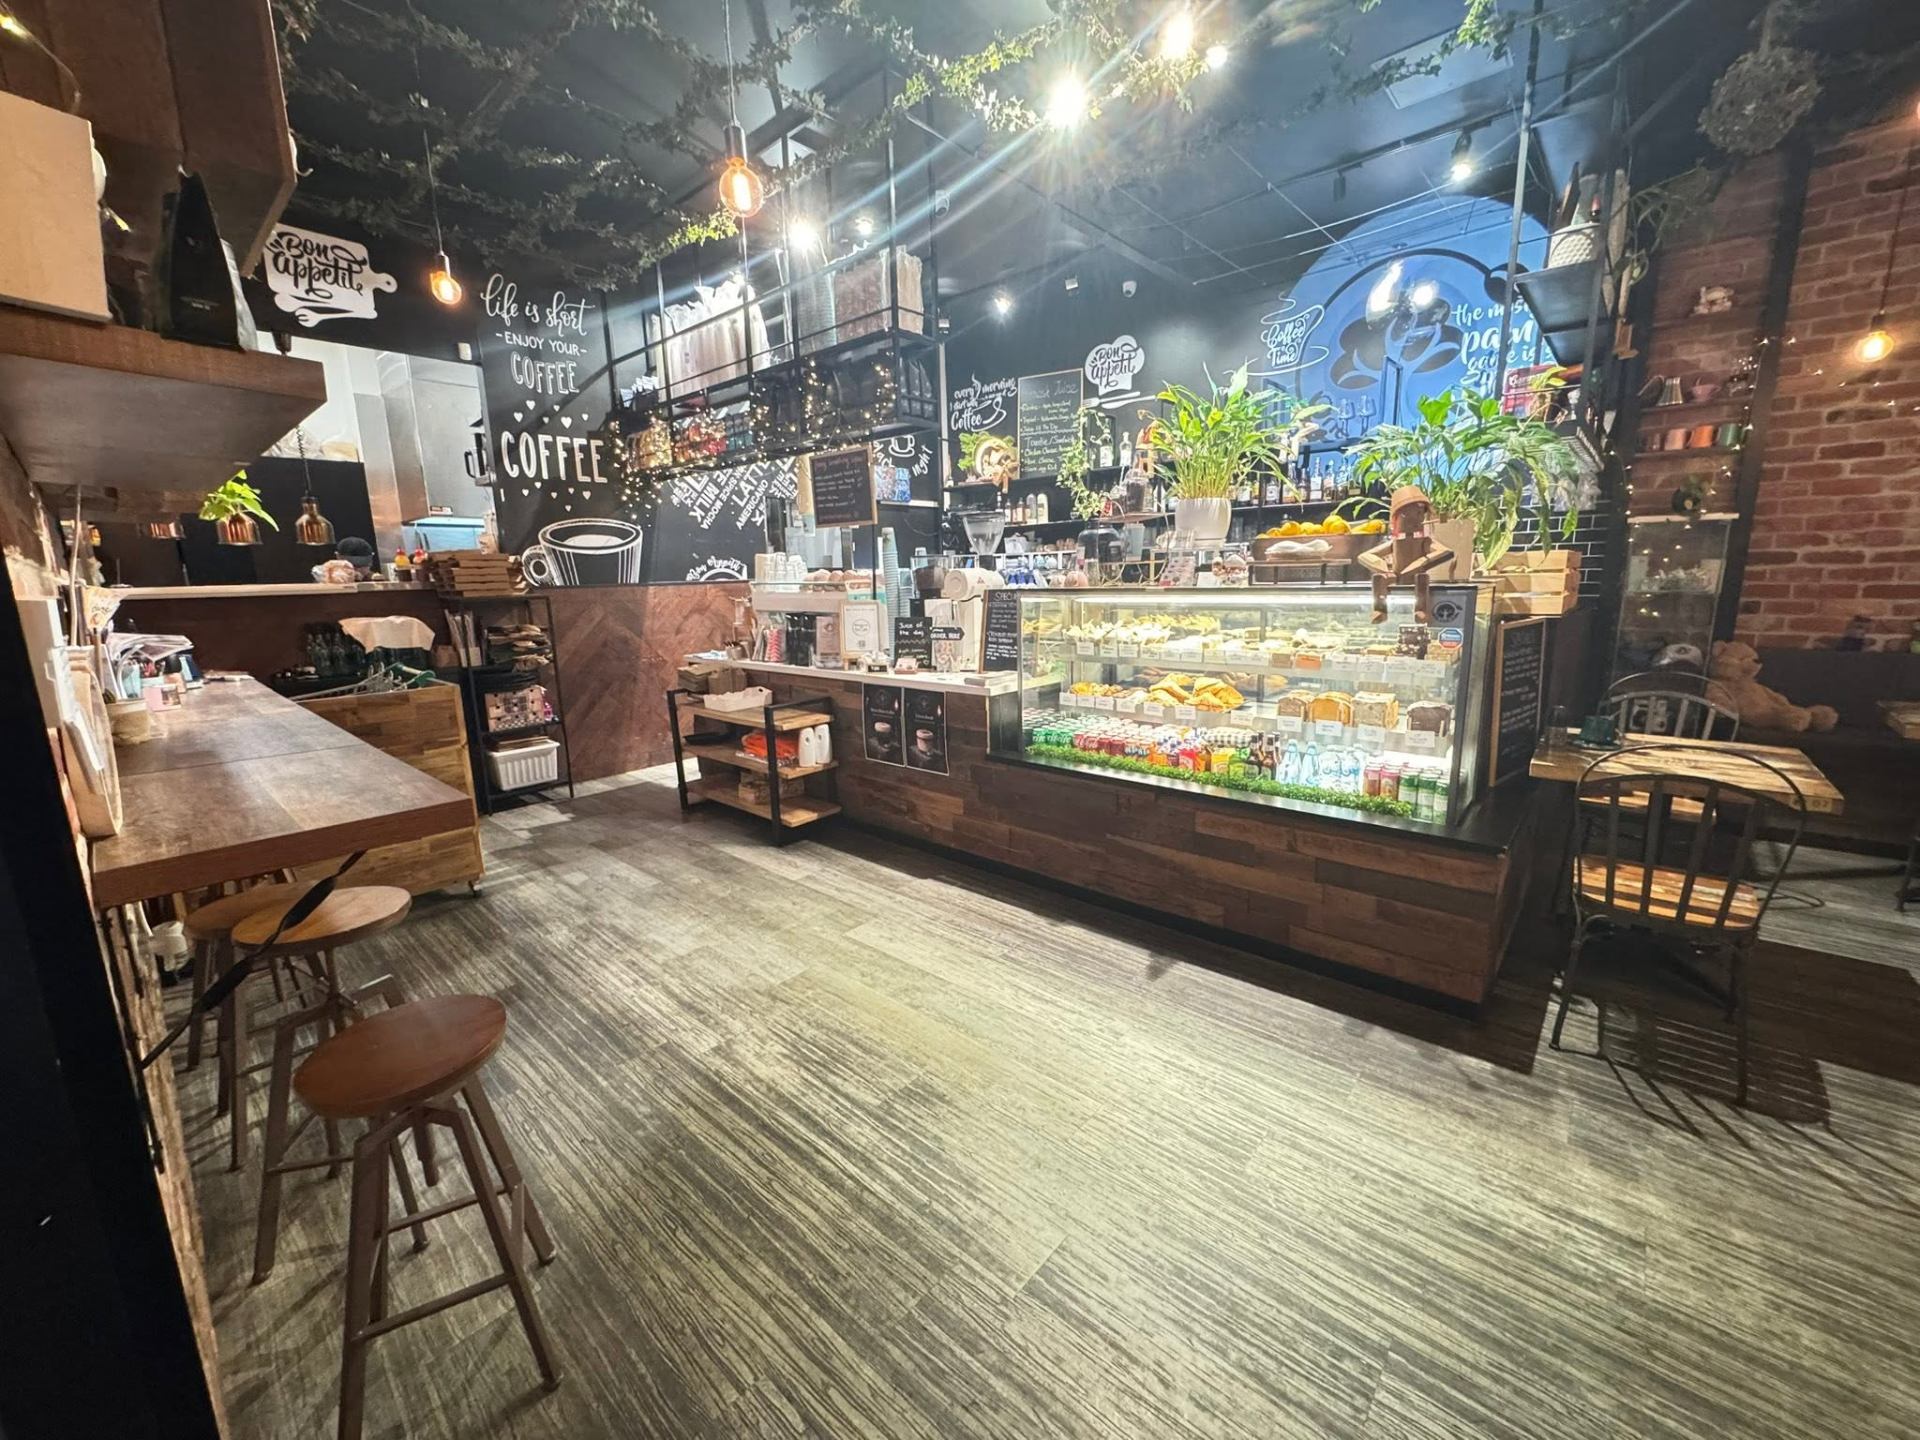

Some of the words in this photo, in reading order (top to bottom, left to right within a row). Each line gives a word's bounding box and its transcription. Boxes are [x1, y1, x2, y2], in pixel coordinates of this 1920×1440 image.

[480, 273, 519, 327] life
[525, 301, 540, 323] is
[545, 291, 596, 338] short
[1451, 303, 1485, 326] the
[510, 351, 580, 395] COFFEE
[951, 407, 983, 431] Coffee
[501, 430, 608, 484] COFFEE
[688, 482, 721, 523] MILK
[700, 499, 724, 530] MOCHA
[735, 479, 769, 531] AMERICANO
